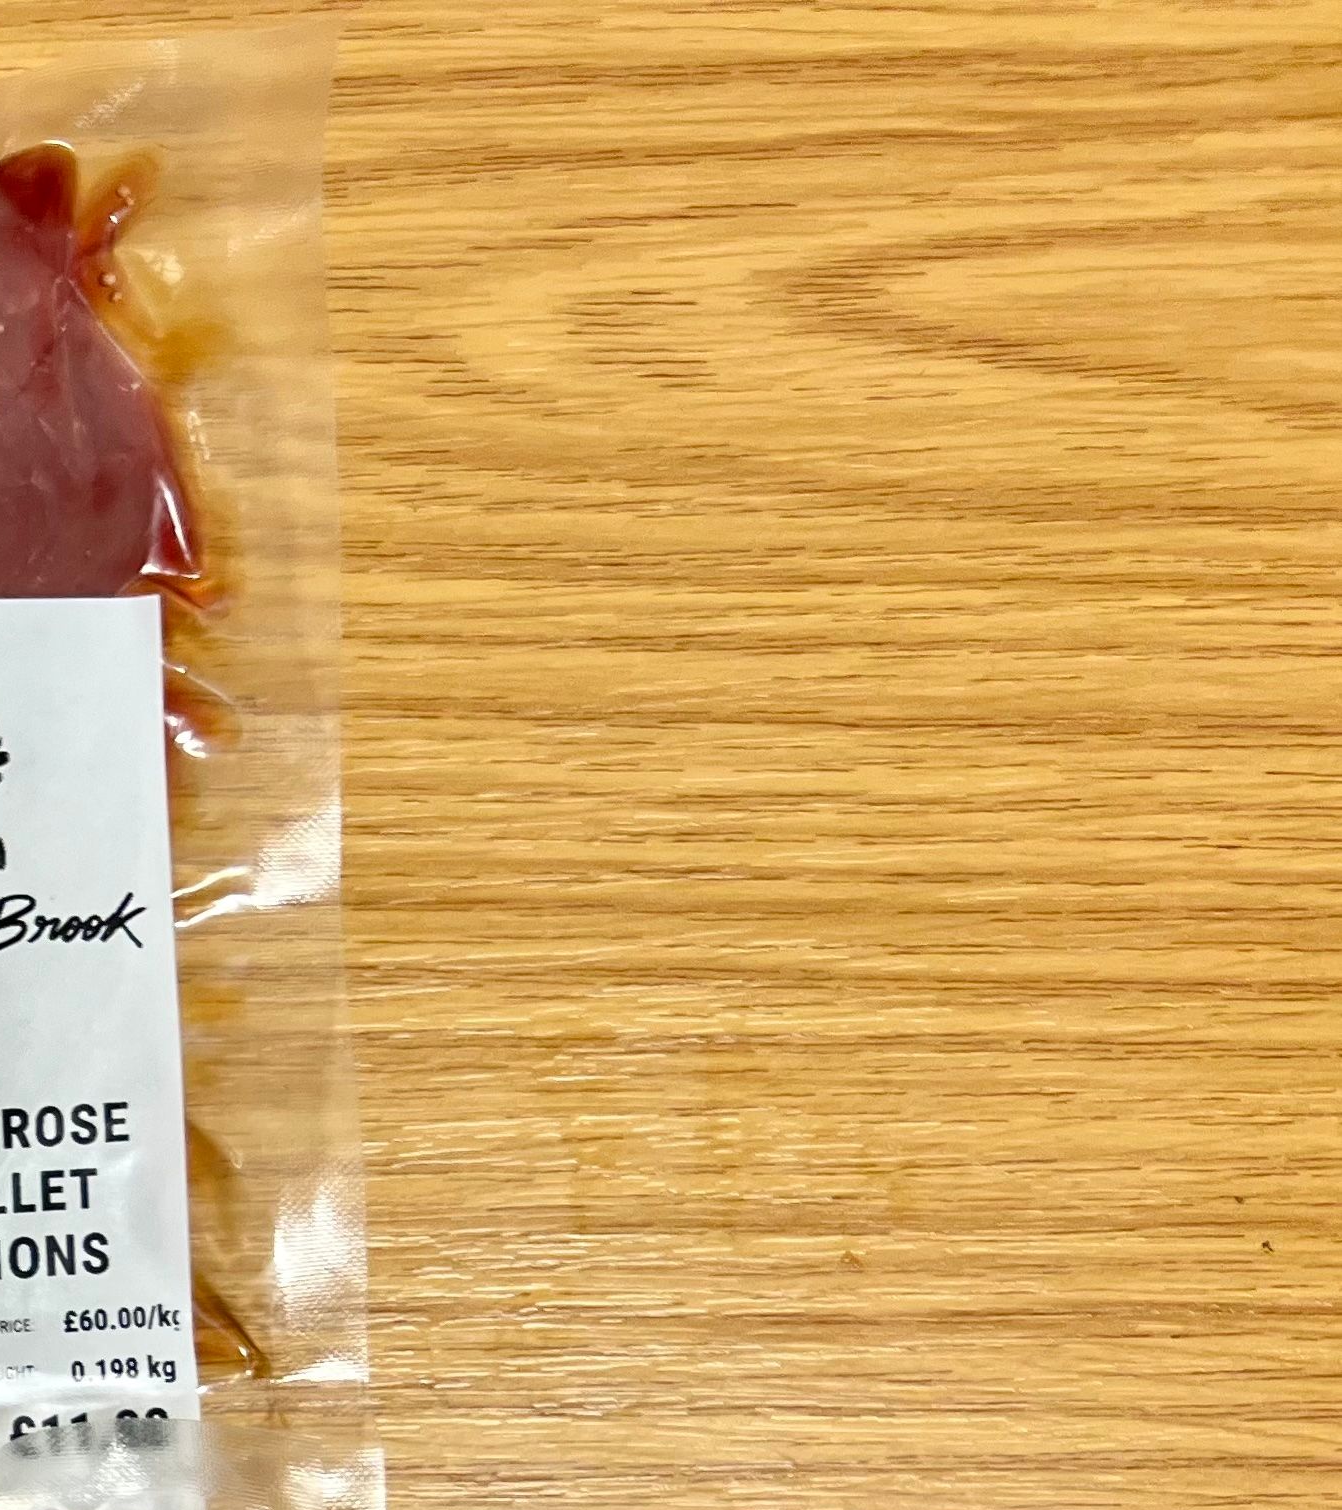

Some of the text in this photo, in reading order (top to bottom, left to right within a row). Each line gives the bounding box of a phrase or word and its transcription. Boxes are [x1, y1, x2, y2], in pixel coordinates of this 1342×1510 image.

[2, 1101, 130, 1150] ROSE
[71, 1354, 177, 1383] 0.198 kg
